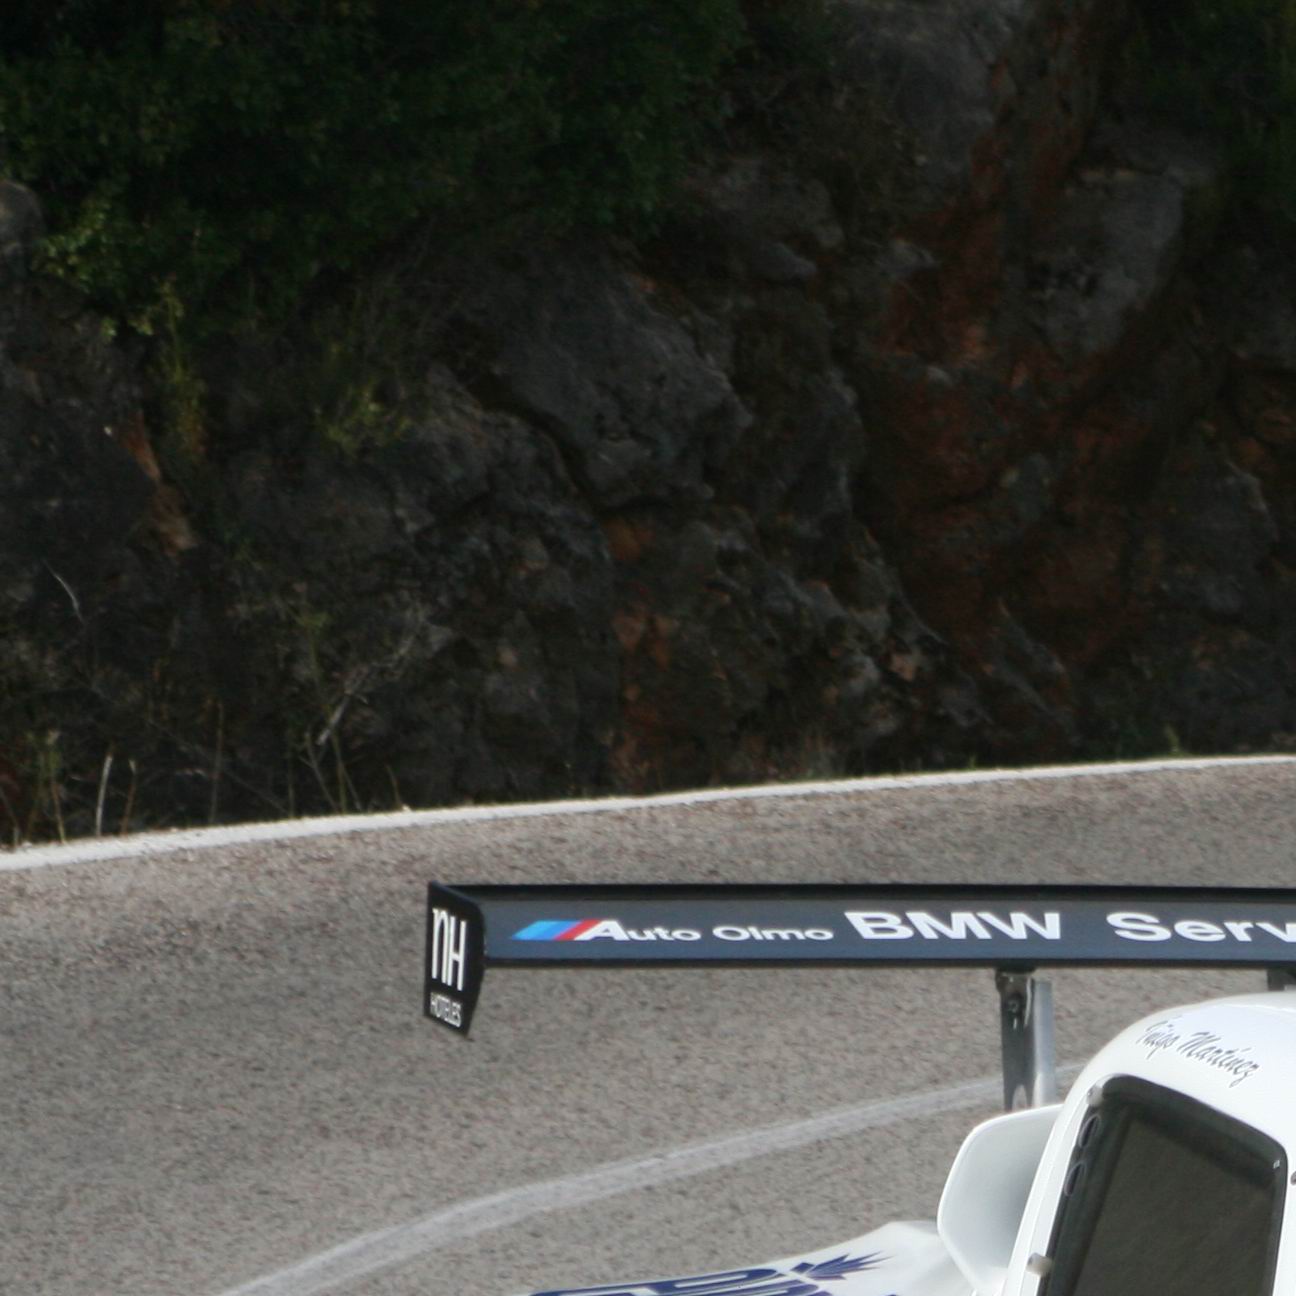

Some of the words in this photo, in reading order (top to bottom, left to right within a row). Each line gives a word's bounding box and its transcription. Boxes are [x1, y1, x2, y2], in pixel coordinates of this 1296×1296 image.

[575, 919, 701, 942] Auto
[712, 924, 834, 942] Olmo
[845, 911, 1062, 941] BMW
